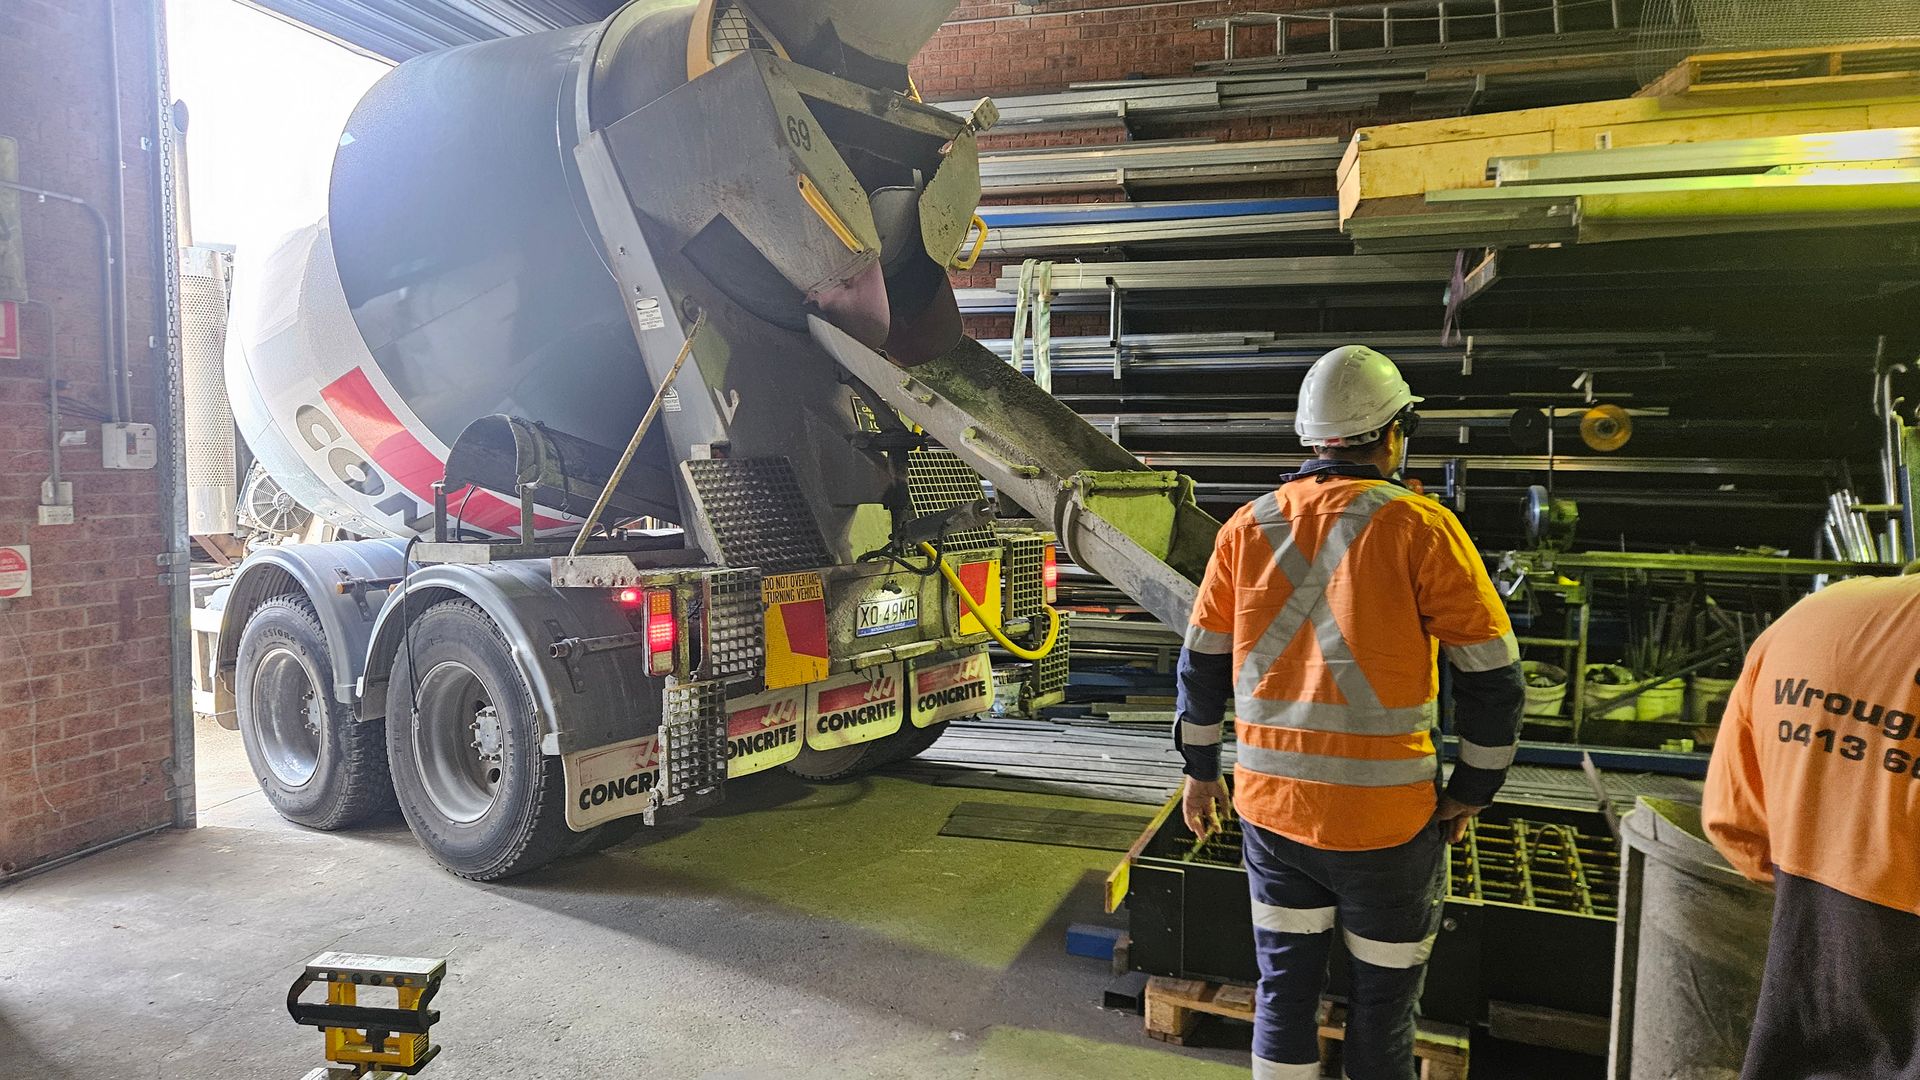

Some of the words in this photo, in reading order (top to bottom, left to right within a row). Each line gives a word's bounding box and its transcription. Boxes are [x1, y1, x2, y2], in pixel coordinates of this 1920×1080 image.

[787, 115, 811, 151] 69
[295, 404, 436, 533] CON
[764, 577, 775, 591] DO
[775, 575, 789, 590] NOT
[790, 572, 819, 588] OVERTAKE
[765, 589, 796, 605] TURNING
[797, 585, 821, 601] VEHICLE
[916, 680, 987, 713] CONCRITE
[1774, 677, 1920, 741] Wroug
[816, 700, 896, 735] CONCRITE
[727, 723, 797, 761] ONCRITE
[1778, 719, 1867, 762] 0413
[578, 768, 660, 811] CONCRI
